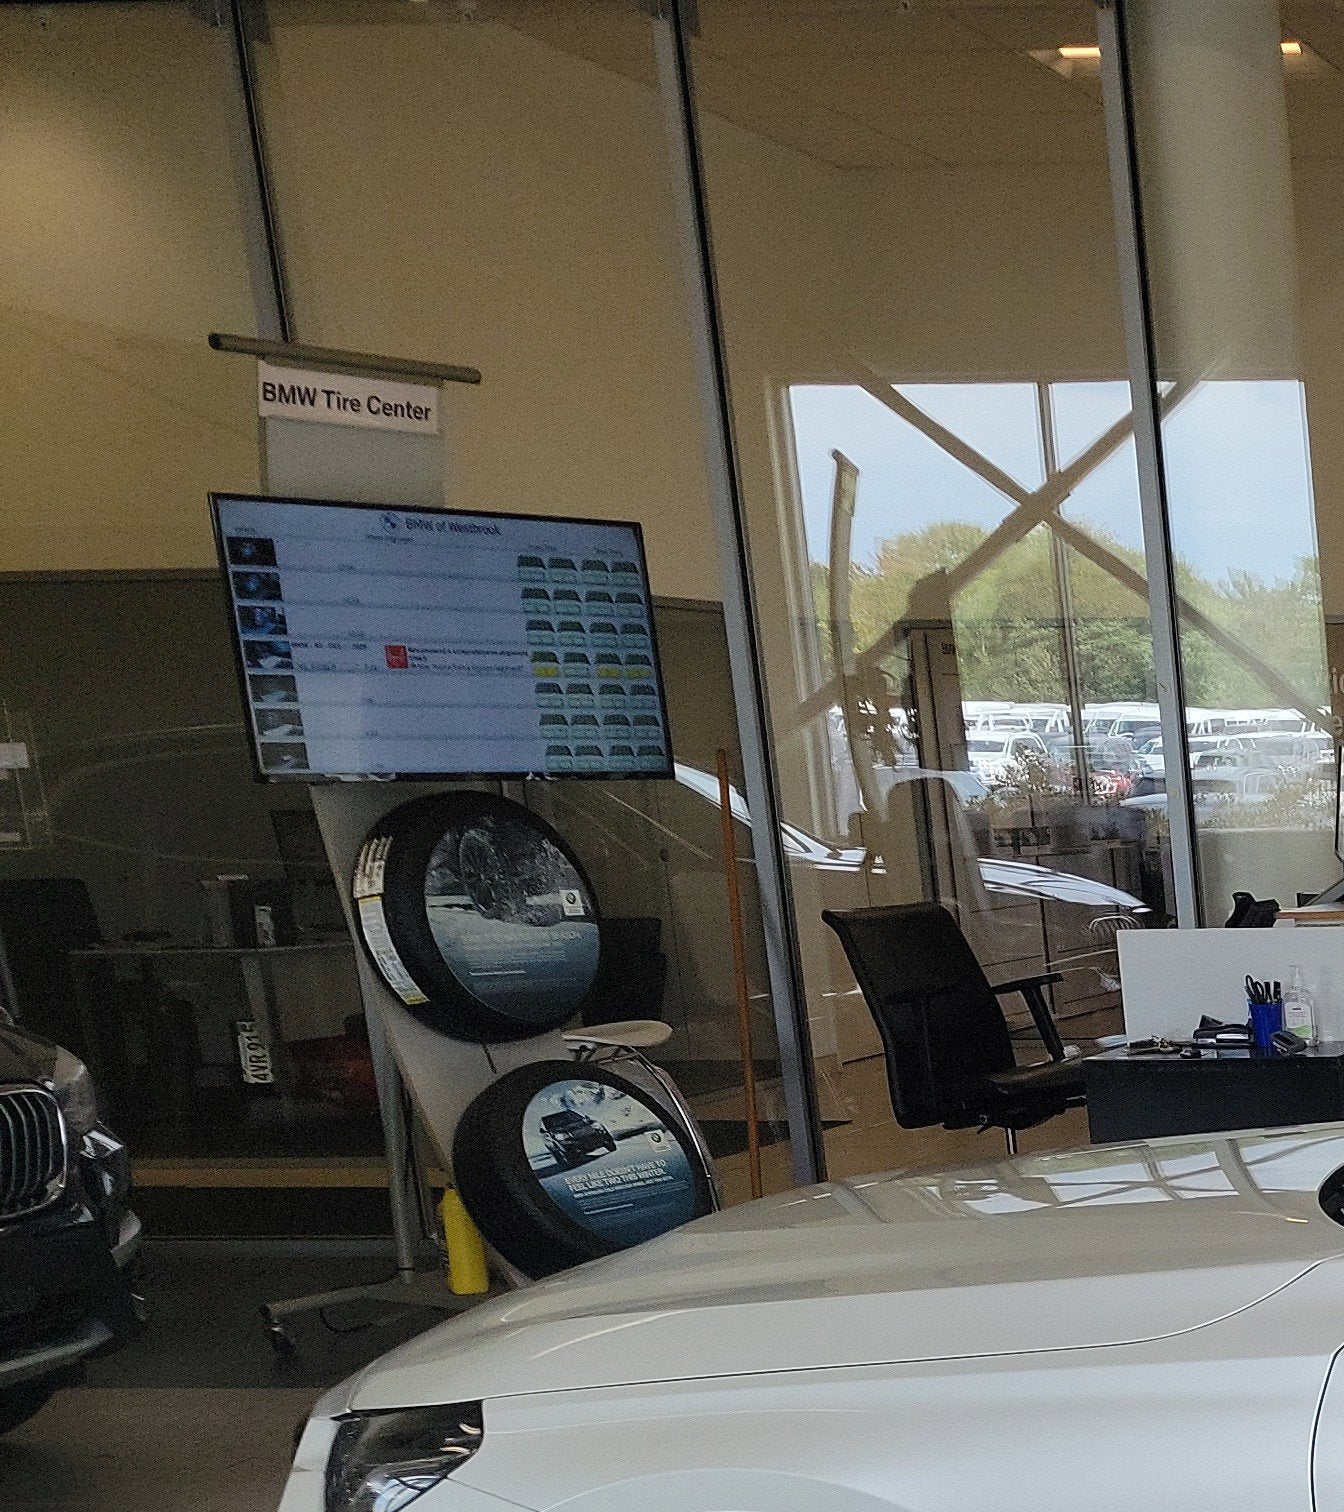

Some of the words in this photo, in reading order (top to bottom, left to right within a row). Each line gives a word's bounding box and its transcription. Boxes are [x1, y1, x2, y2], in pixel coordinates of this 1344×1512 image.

[262, 381, 317, 407] BMW
[321, 389, 361, 413] Tire
[366, 395, 432, 420] Center
[405, 518, 433, 531] BMW
